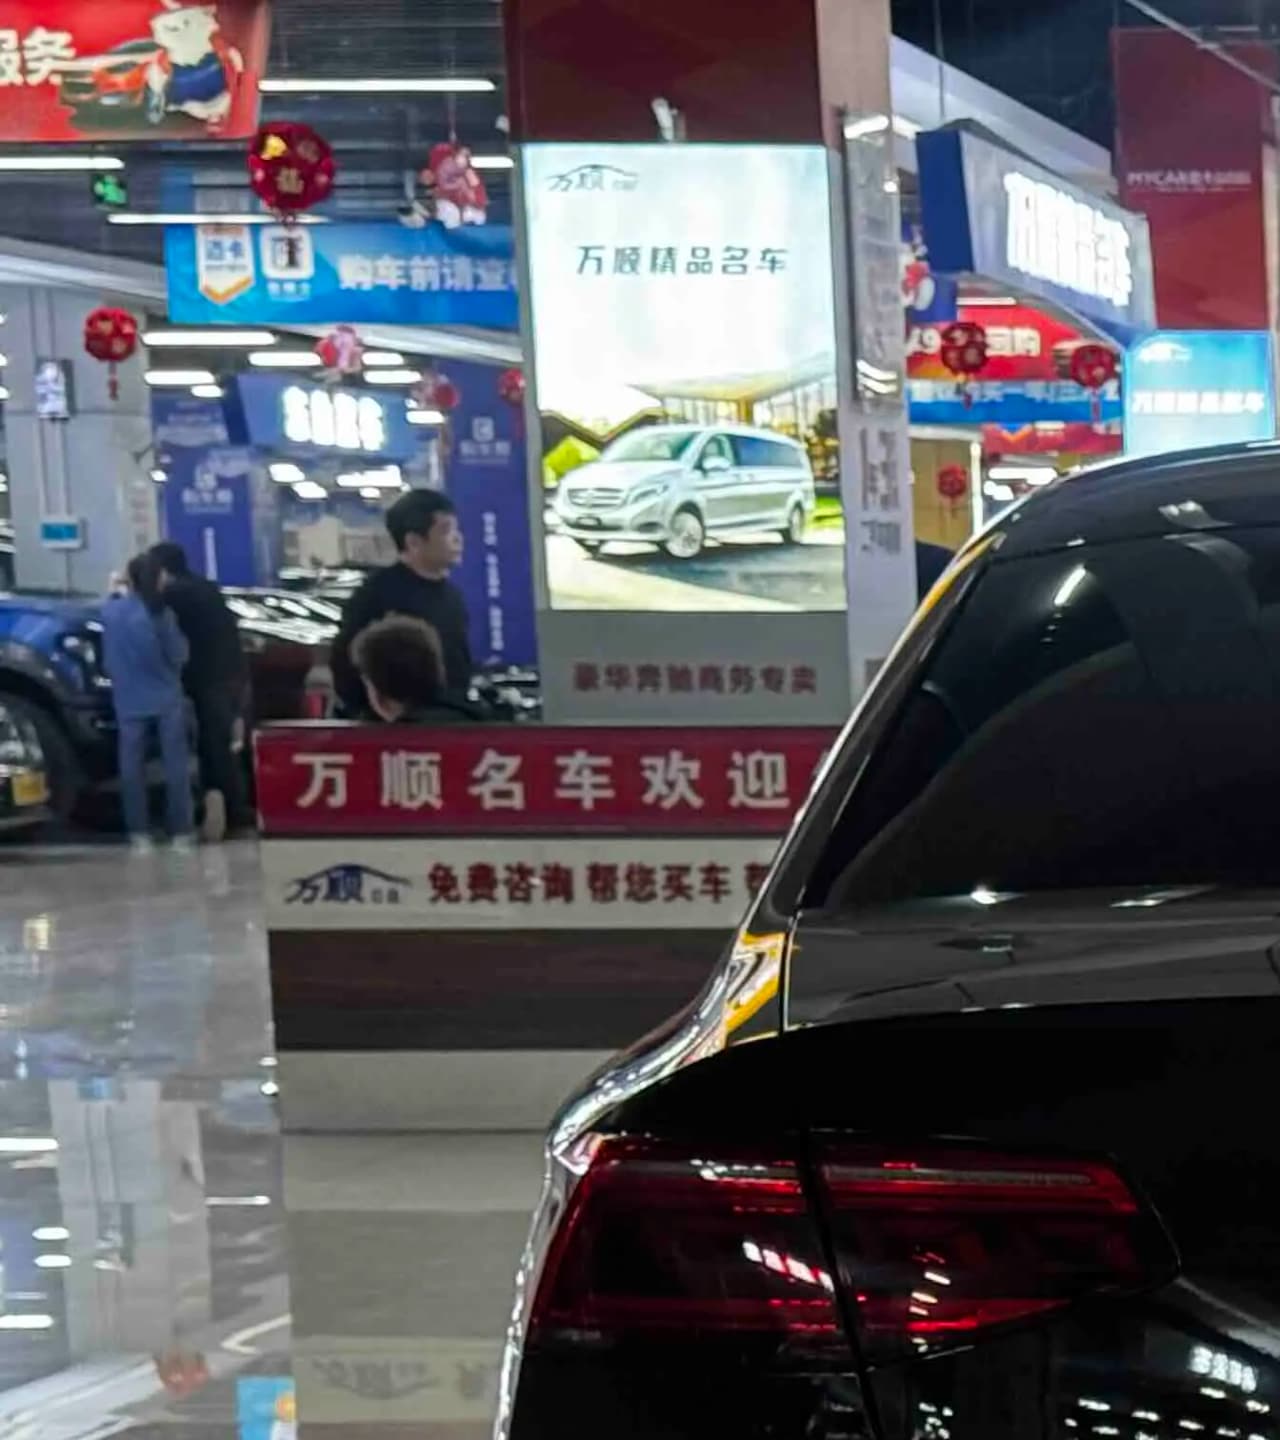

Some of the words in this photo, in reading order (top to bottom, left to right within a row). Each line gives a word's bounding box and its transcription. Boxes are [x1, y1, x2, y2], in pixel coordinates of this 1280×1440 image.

[576, 245, 788, 276] 万顺精品名车
[292, 749, 830, 809] 万顺名车欢迎
[427, 863, 575, 903] 免费咨询
